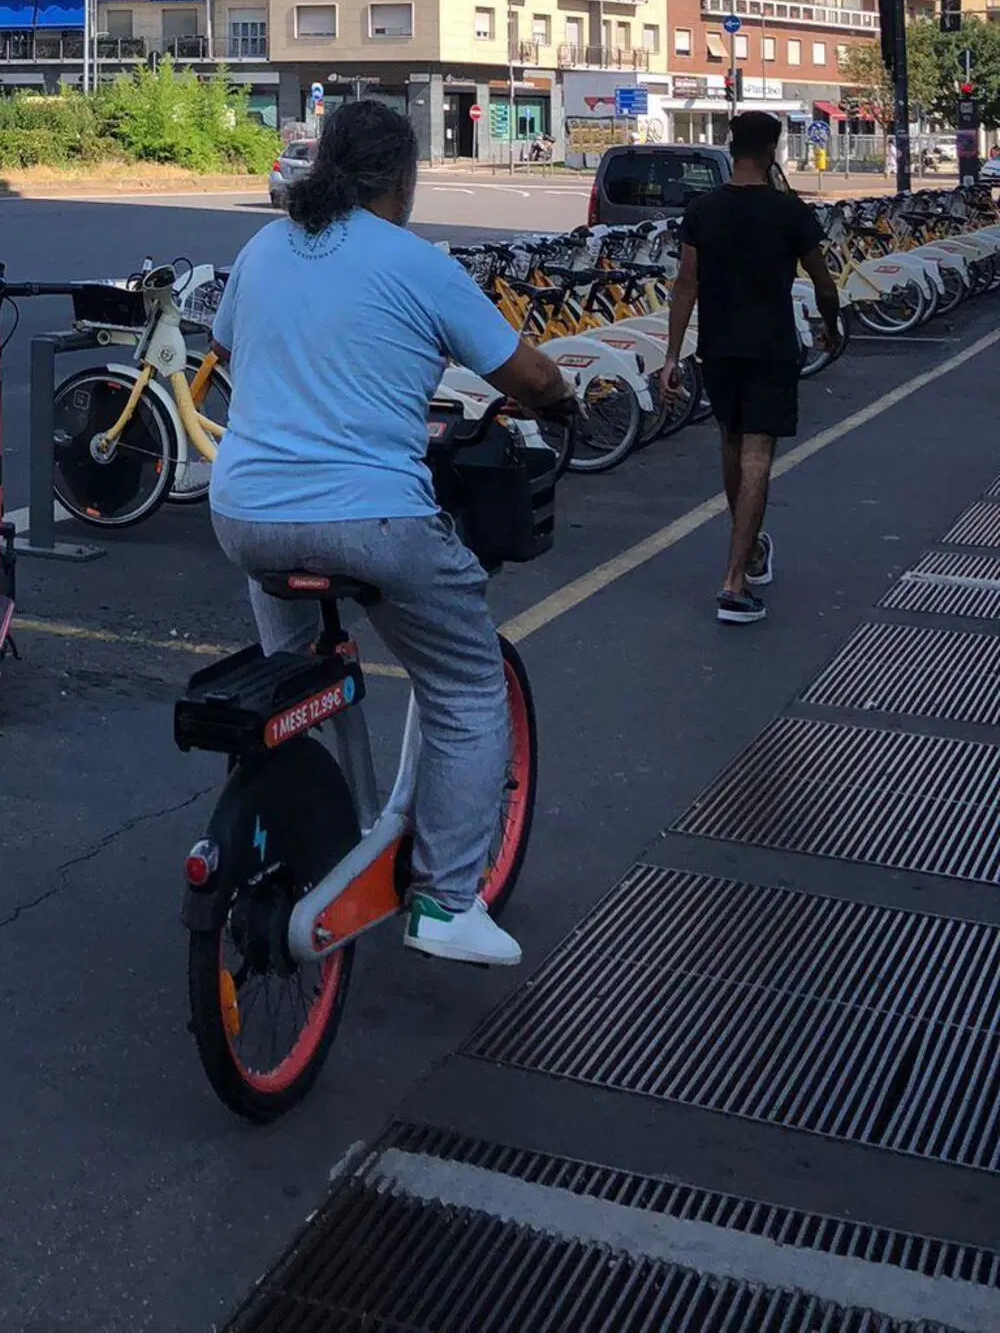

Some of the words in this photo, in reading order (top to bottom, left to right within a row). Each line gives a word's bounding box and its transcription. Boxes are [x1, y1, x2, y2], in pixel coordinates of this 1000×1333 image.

[272, 722, 278, 740] 1
[280, 705, 308, 737] MESE
[309, 688, 341, 719] 12.99€
